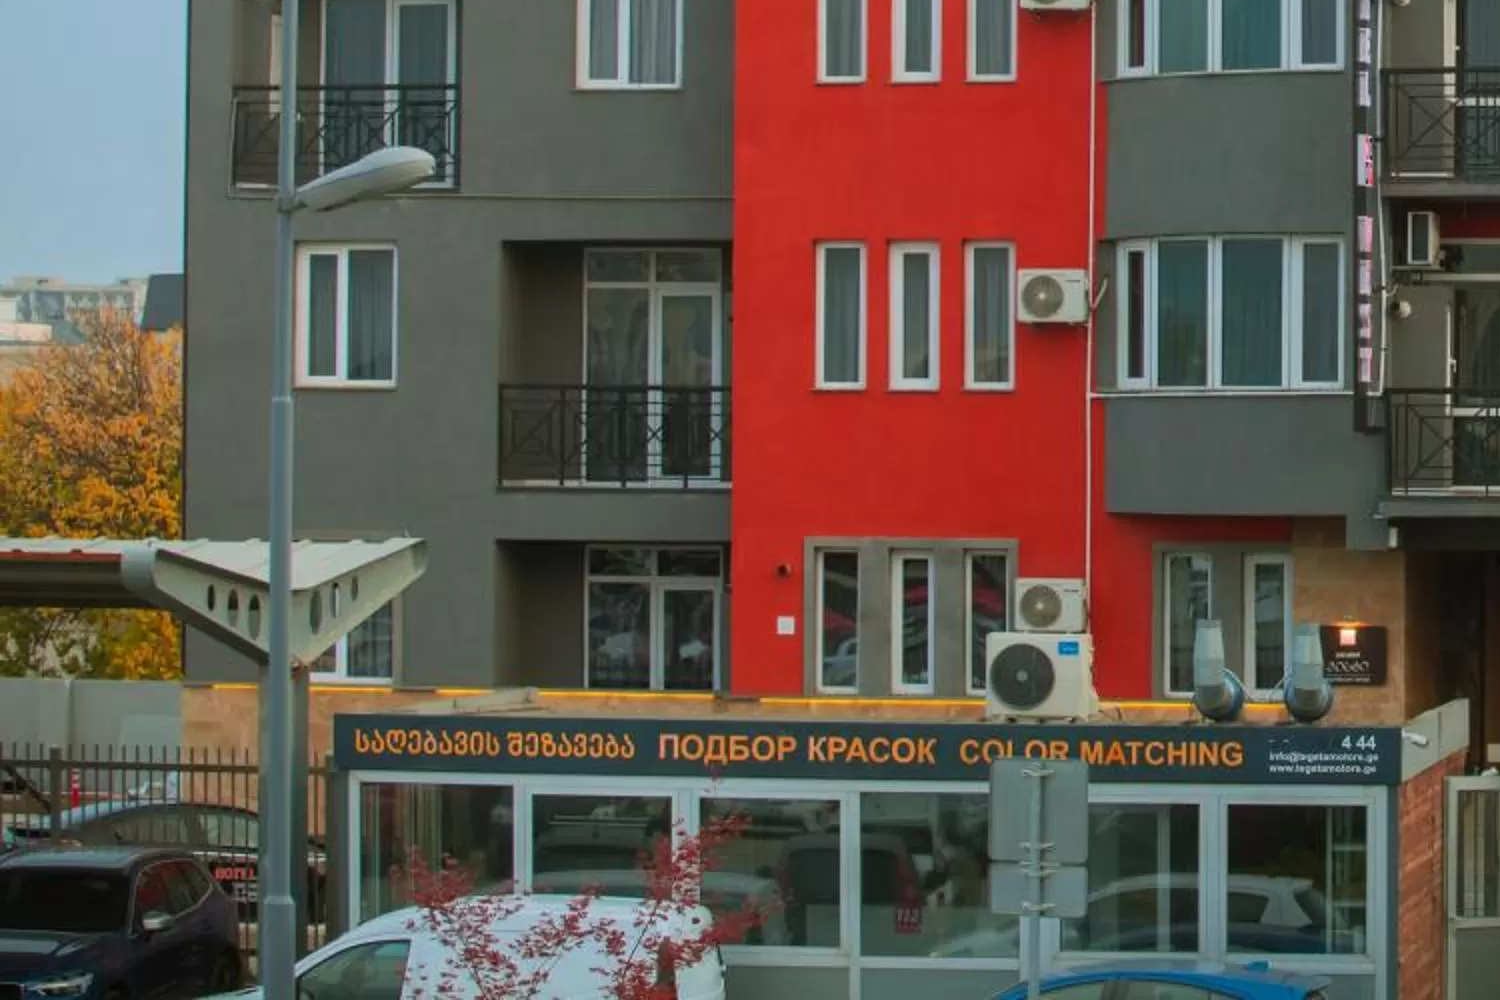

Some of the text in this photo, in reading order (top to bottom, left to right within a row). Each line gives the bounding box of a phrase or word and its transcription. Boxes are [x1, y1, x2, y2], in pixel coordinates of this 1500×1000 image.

[658, 732, 937, 765] ПОДБОР КРАСОК
[1080, 740, 1244, 767] MATCHING
